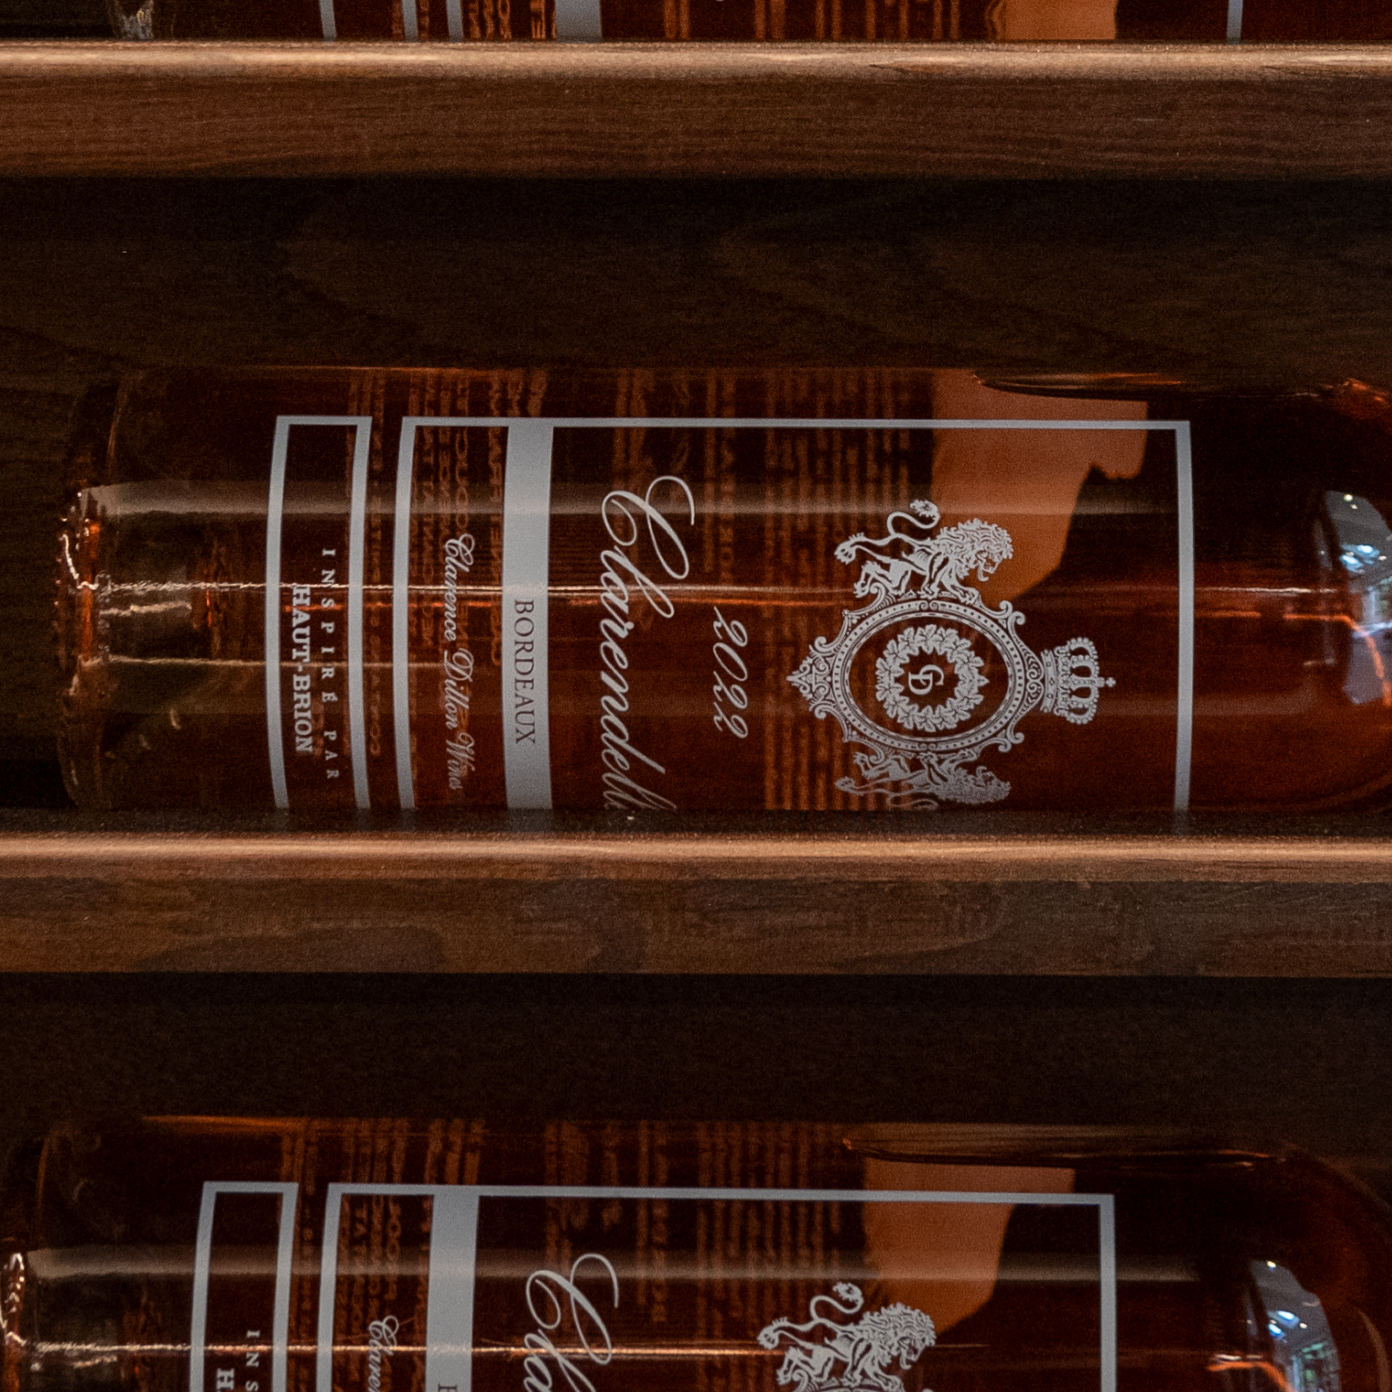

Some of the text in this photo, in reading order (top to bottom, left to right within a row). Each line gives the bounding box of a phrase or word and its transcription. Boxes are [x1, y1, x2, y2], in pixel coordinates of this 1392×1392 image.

[291, 584, 313, 753] HAUT-BRION
[320, 548, 341, 780] INSPIRÉ PAR
[442, 533, 476, 790] Clarence Dillon Wines
[513, 599, 536, 744] BORDEAUX
[712, 605, 749, 739] 2022
